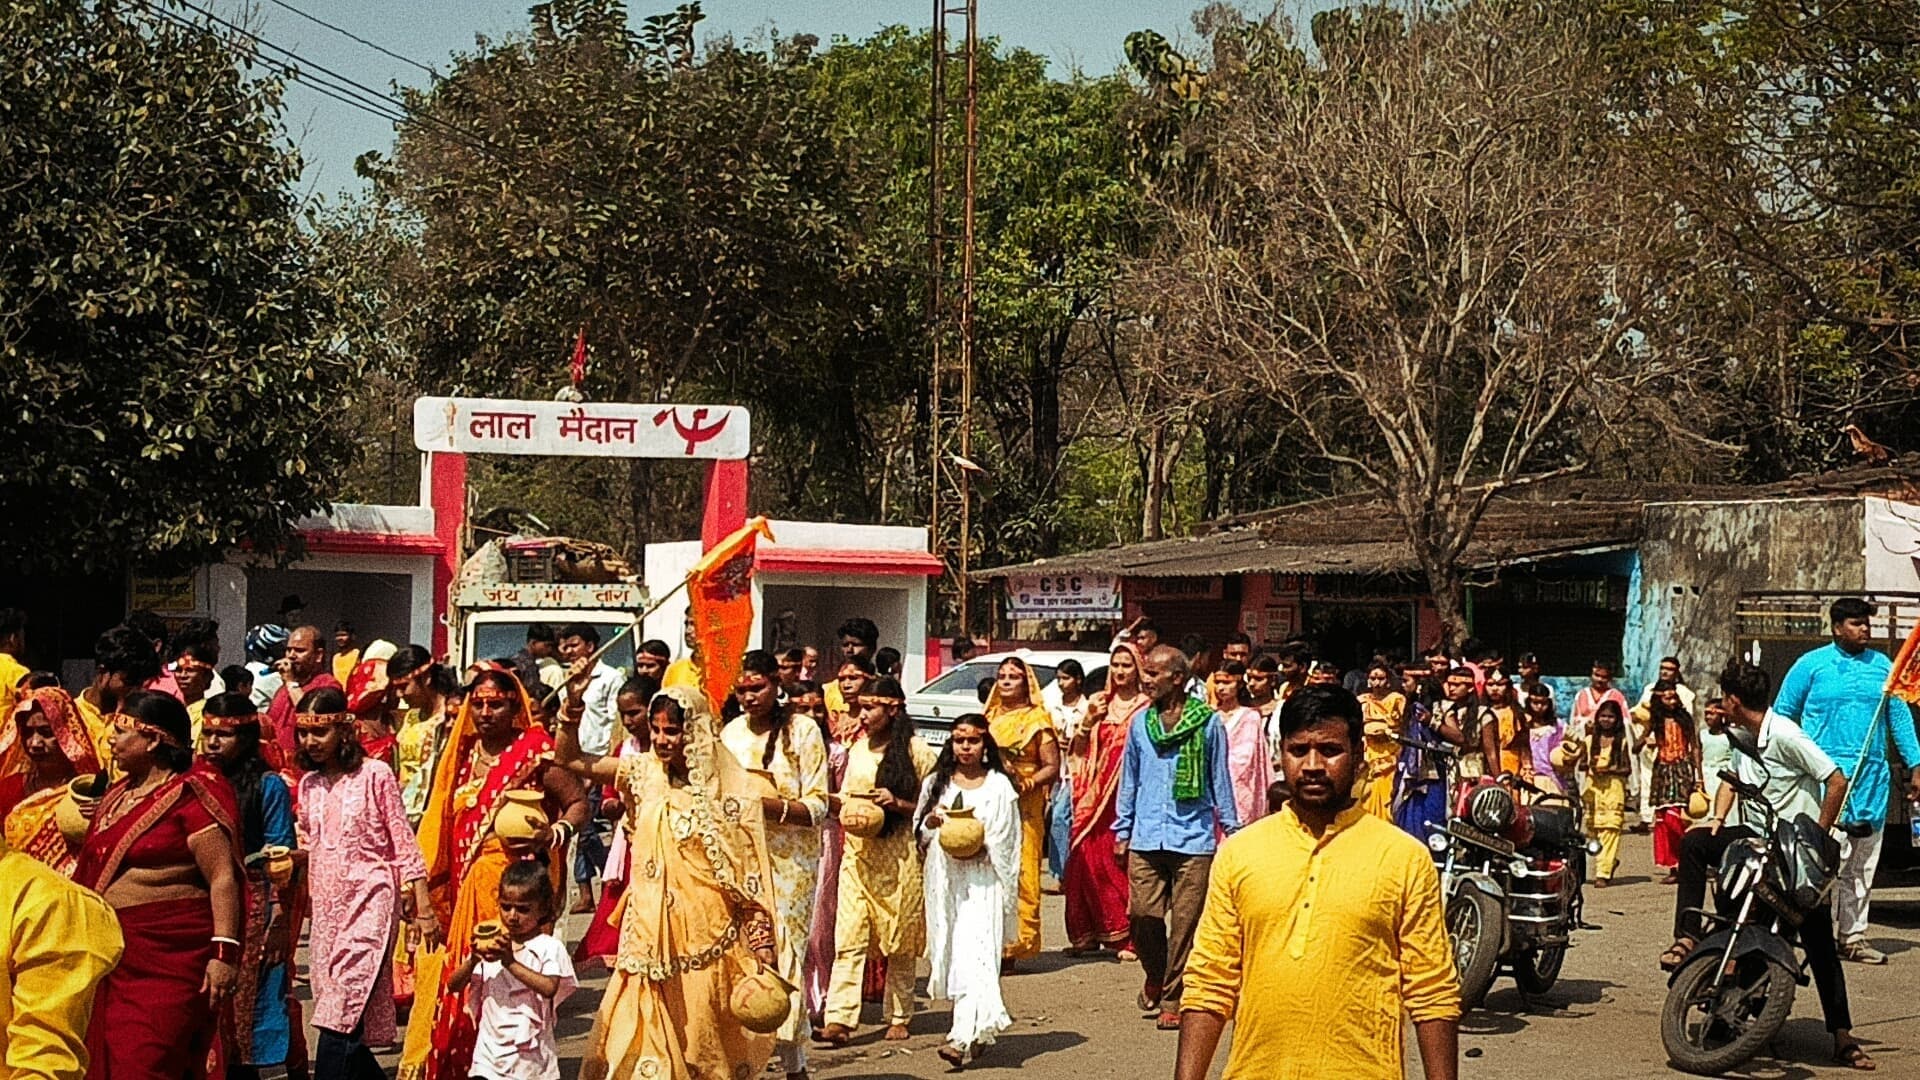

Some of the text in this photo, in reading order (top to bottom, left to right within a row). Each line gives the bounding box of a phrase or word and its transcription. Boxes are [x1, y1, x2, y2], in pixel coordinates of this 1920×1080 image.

[469, 407, 639, 444] लाल मैदान
[483, 588, 520, 602] जय
[592, 588, 630, 602] तारा
